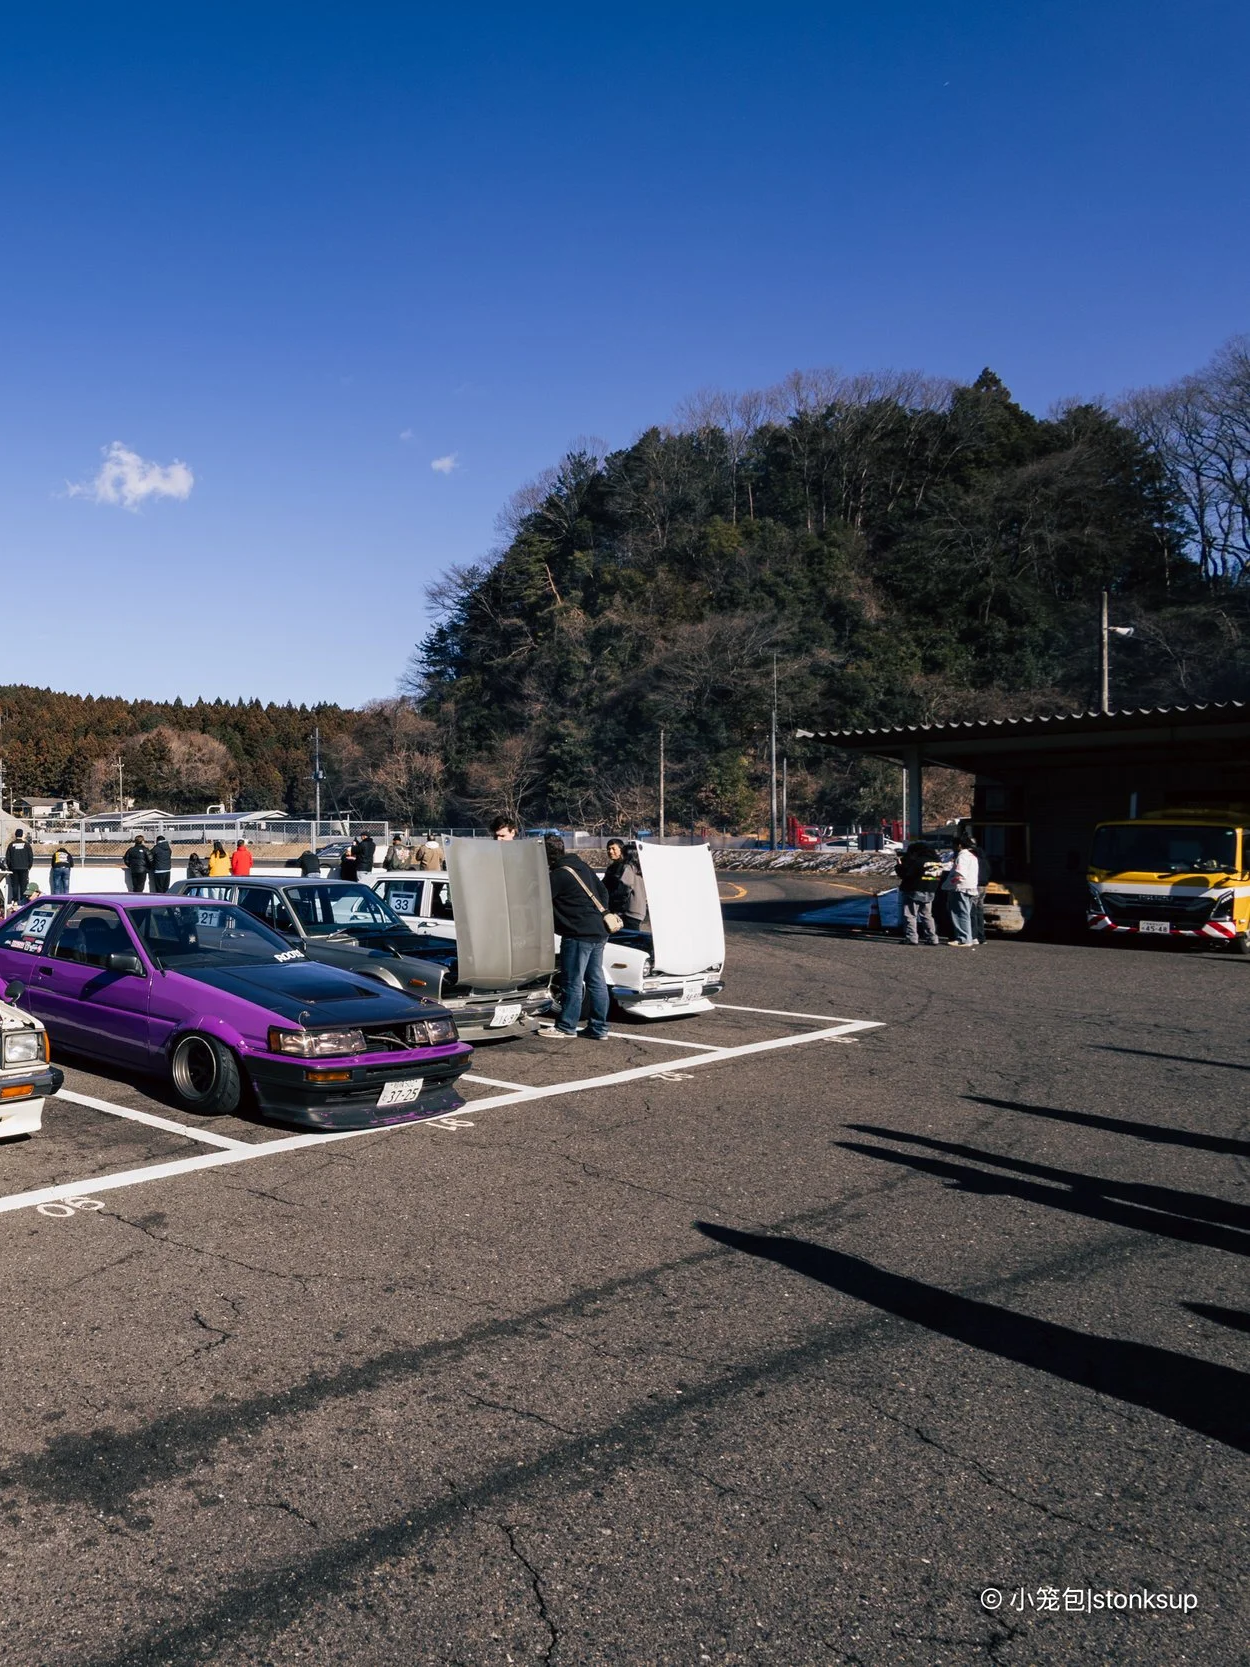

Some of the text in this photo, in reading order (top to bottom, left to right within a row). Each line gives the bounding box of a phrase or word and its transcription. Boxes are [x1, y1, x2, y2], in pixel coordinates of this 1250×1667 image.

[394, 899, 409, 911] 33
[200, 911, 214, 925] 21
[29, 918, 46, 933] 23
[387, 1087, 419, 1104] 37-25
